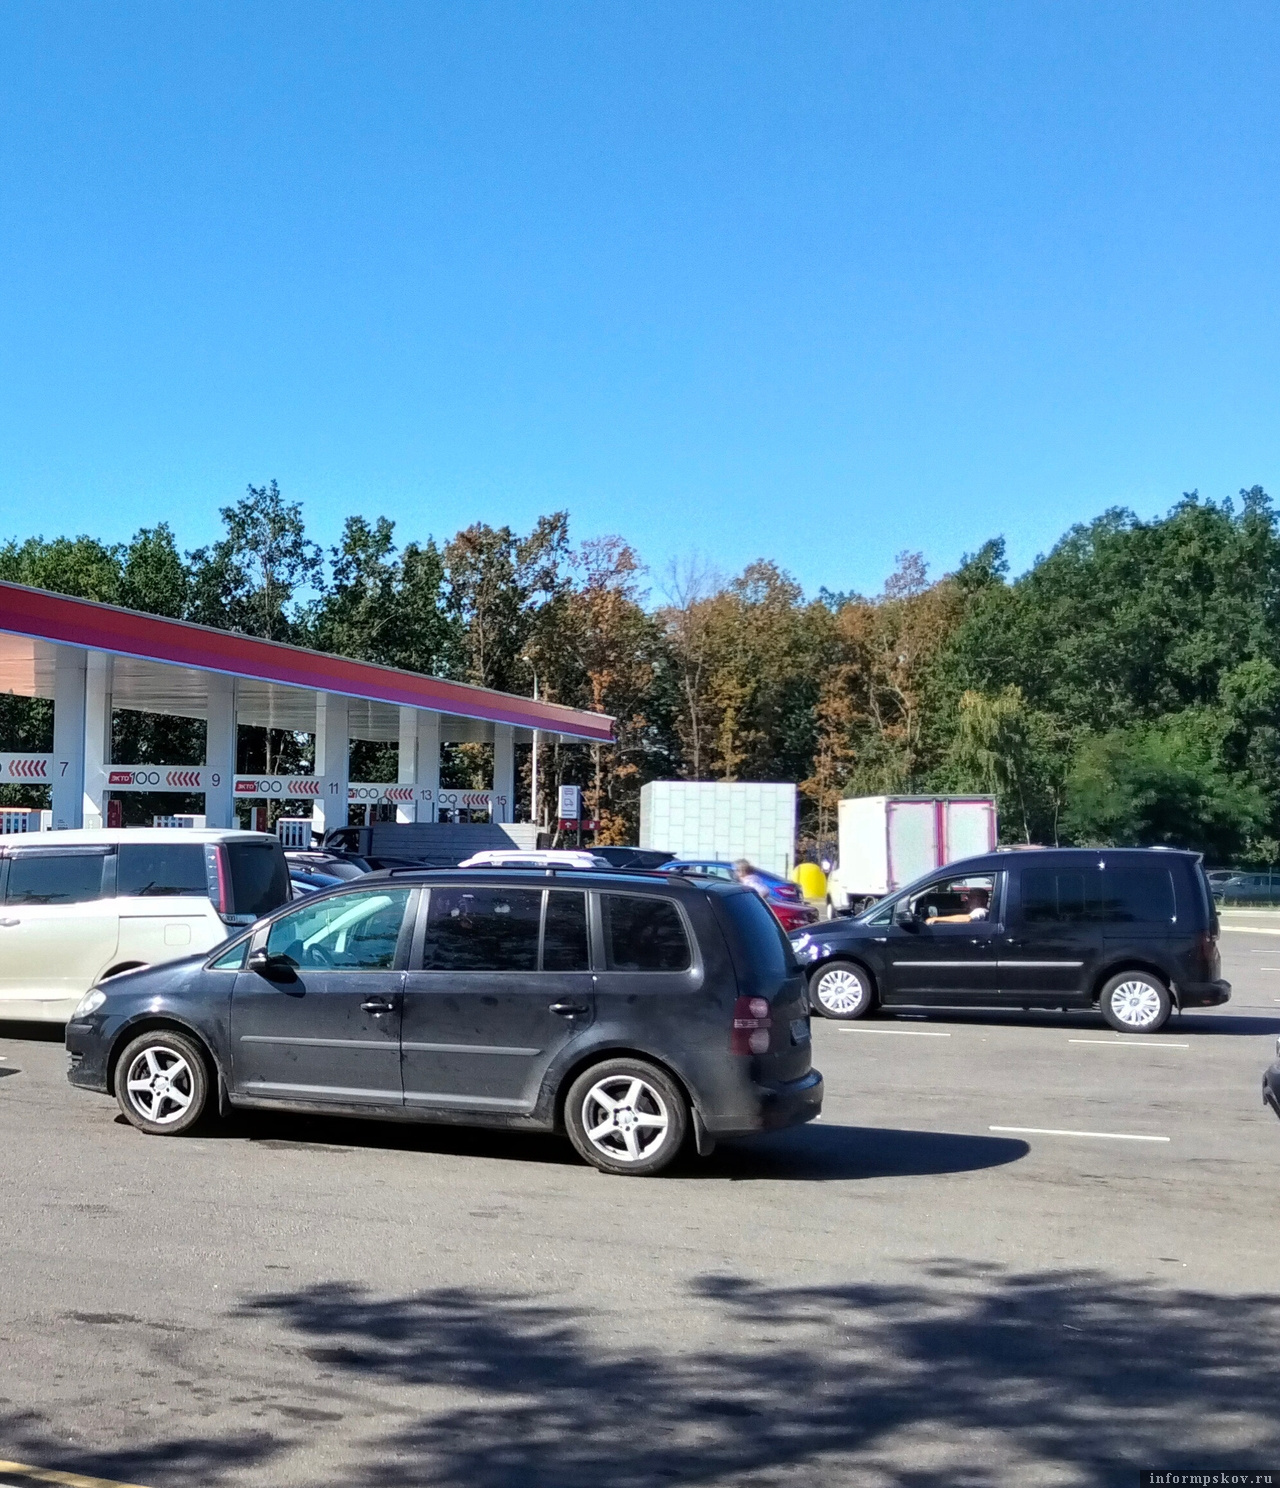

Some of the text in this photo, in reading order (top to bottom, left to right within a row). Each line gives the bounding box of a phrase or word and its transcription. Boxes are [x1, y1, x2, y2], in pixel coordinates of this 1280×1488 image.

[59, 761, 69, 777] 7
[111, 771, 221, 787] ЭКТО 100 9
[254, 780, 282, 793] 100
[328, 782, 339, 795] 11
[353, 788, 379, 800] 100
[420, 789, 433, 801] 13
[438, 793, 507, 806] 00 15
